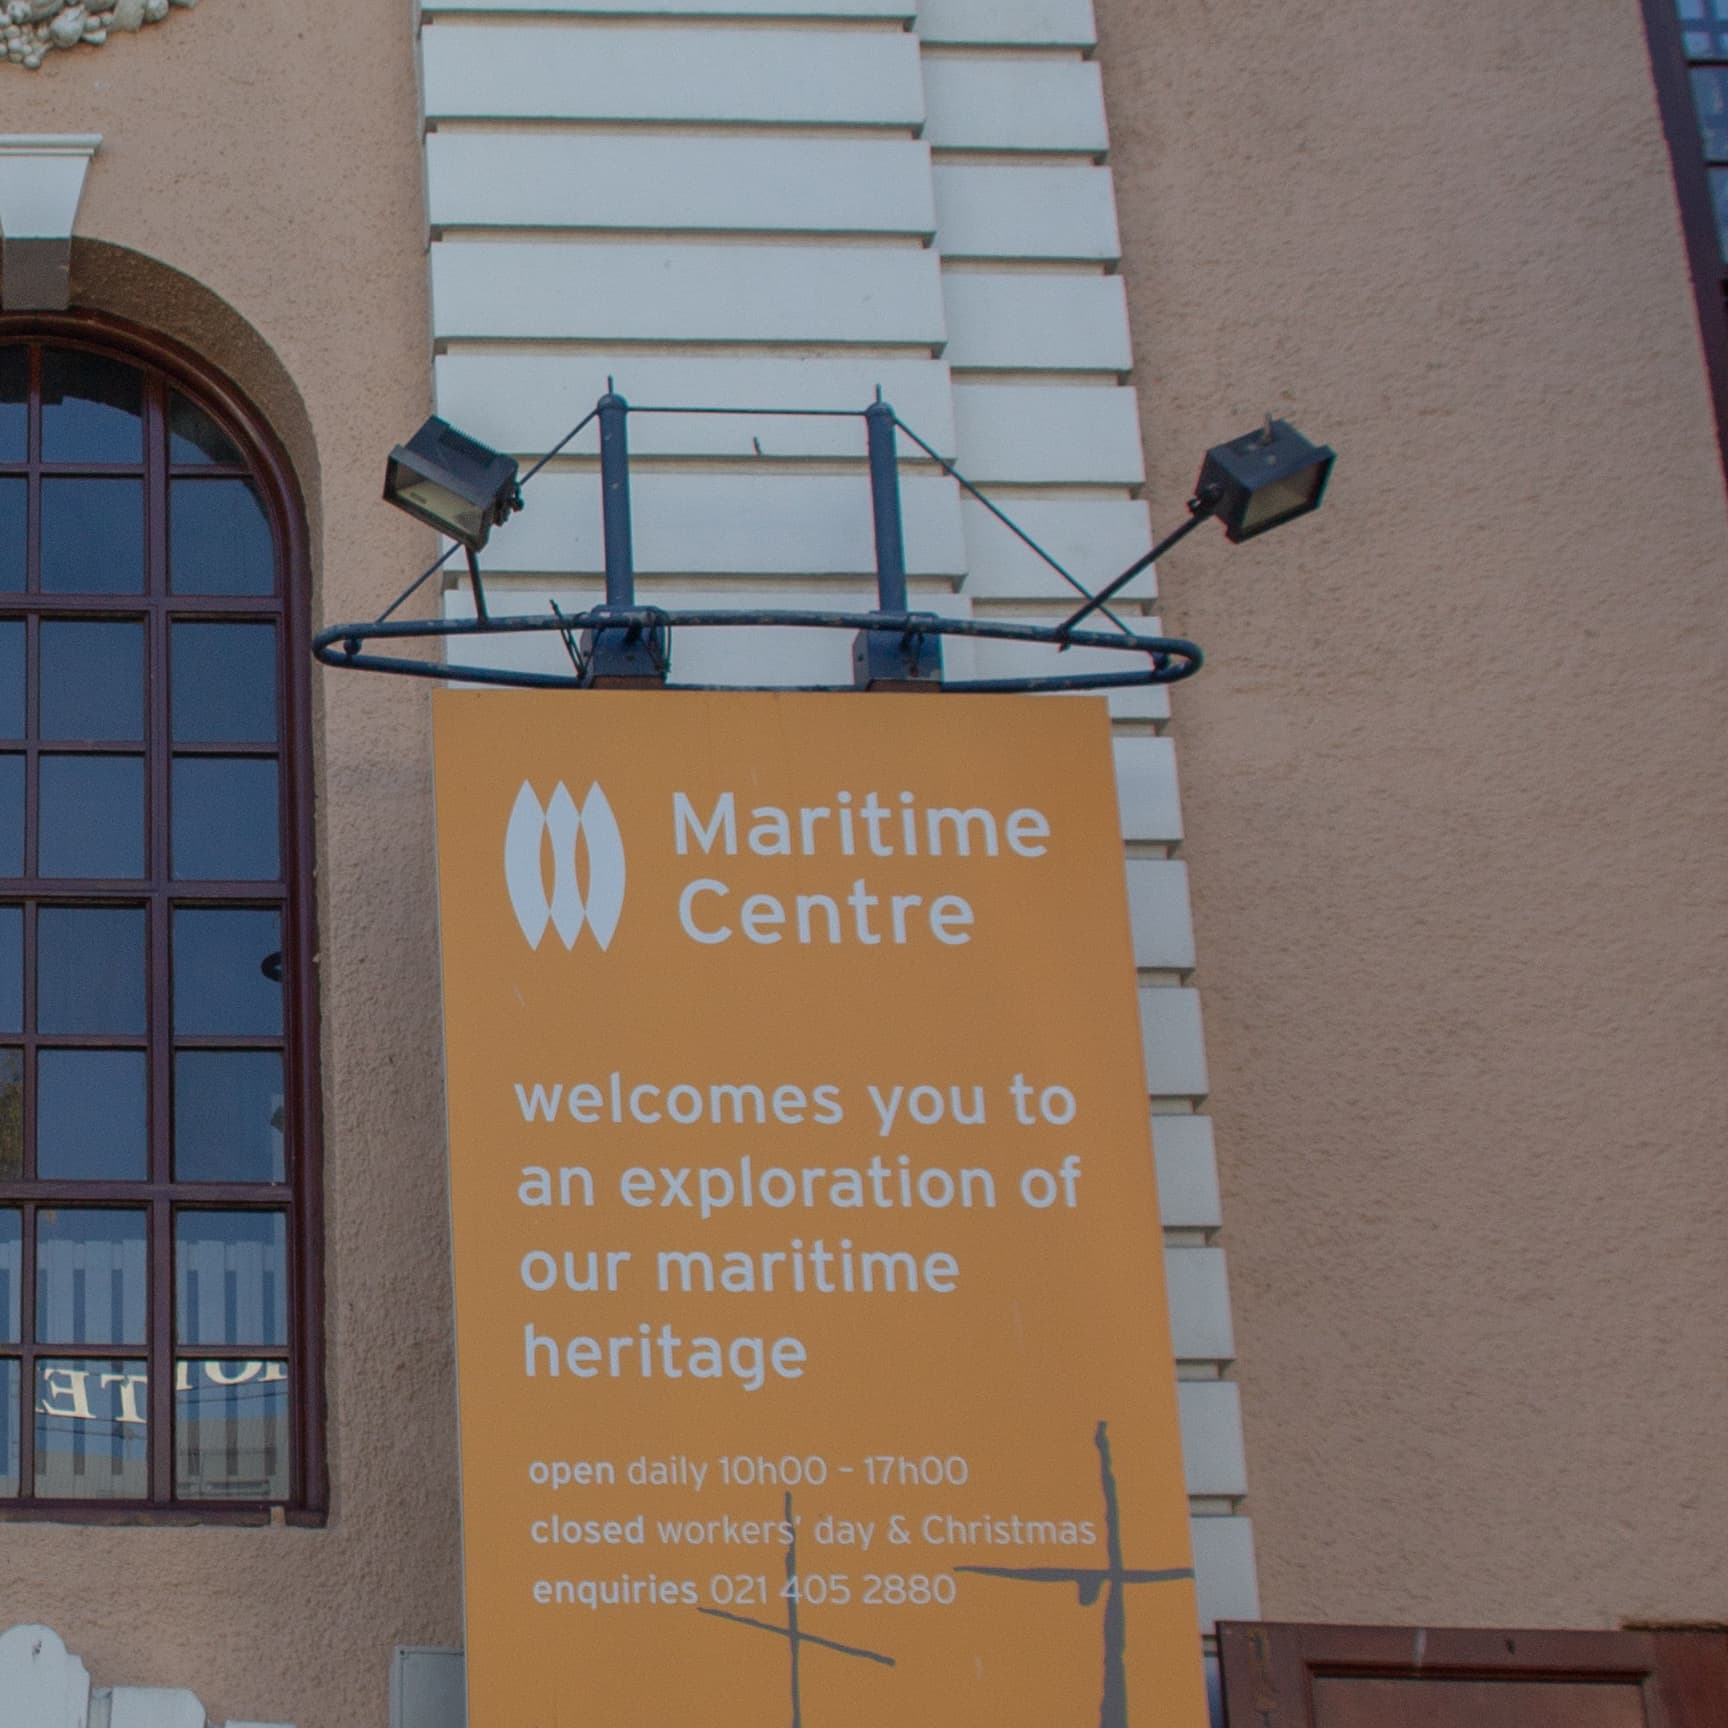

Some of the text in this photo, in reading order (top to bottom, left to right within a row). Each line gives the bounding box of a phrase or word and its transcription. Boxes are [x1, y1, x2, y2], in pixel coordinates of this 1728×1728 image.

[672, 790, 1051, 858] Maritime
[678, 878, 974, 945] Centre
[513, 1071, 1077, 1137] welcomes you to
[517, 1154, 1082, 1219] an exploration of
[520, 1238, 960, 1293] our maritime
[524, 1322, 807, 1392] heritage
[528, 1461, 616, 1490] open
[626, 1455, 709, 1492] daily
[718, 1455, 828, 1486] 10h00
[863, 1455, 969, 1486] 17h00
[530, 1513, 1097, 1551] closed workers' day & Christmas
[532, 1573, 957, 1610] enquiries 021 405 2880
